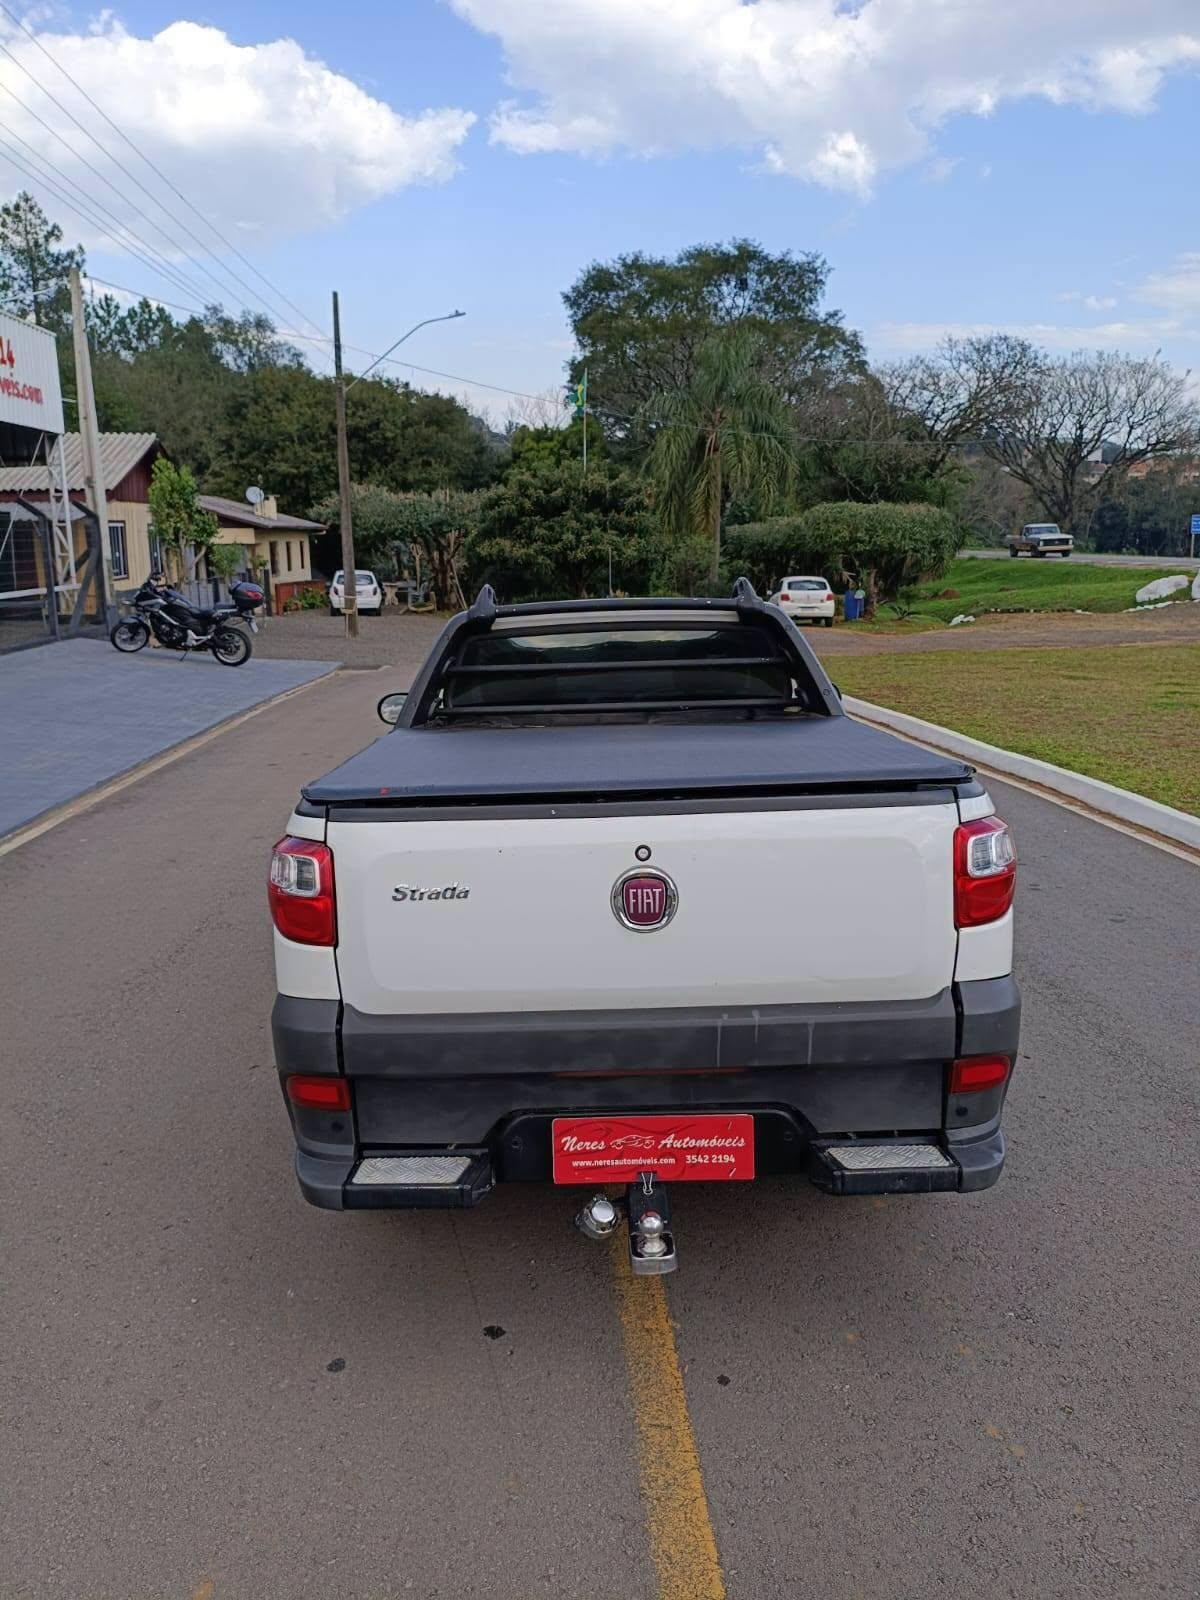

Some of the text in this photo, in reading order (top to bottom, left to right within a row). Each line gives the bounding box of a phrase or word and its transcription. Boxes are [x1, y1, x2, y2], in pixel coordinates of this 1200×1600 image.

[391, 881, 470, 902] Strada
[629, 888, 662, 914] FIAT
[561, 1133, 746, 1152] Neres Automóveis
[685, 1154, 710, 1164] 3542
[711, 1154, 736, 1164] 2194
